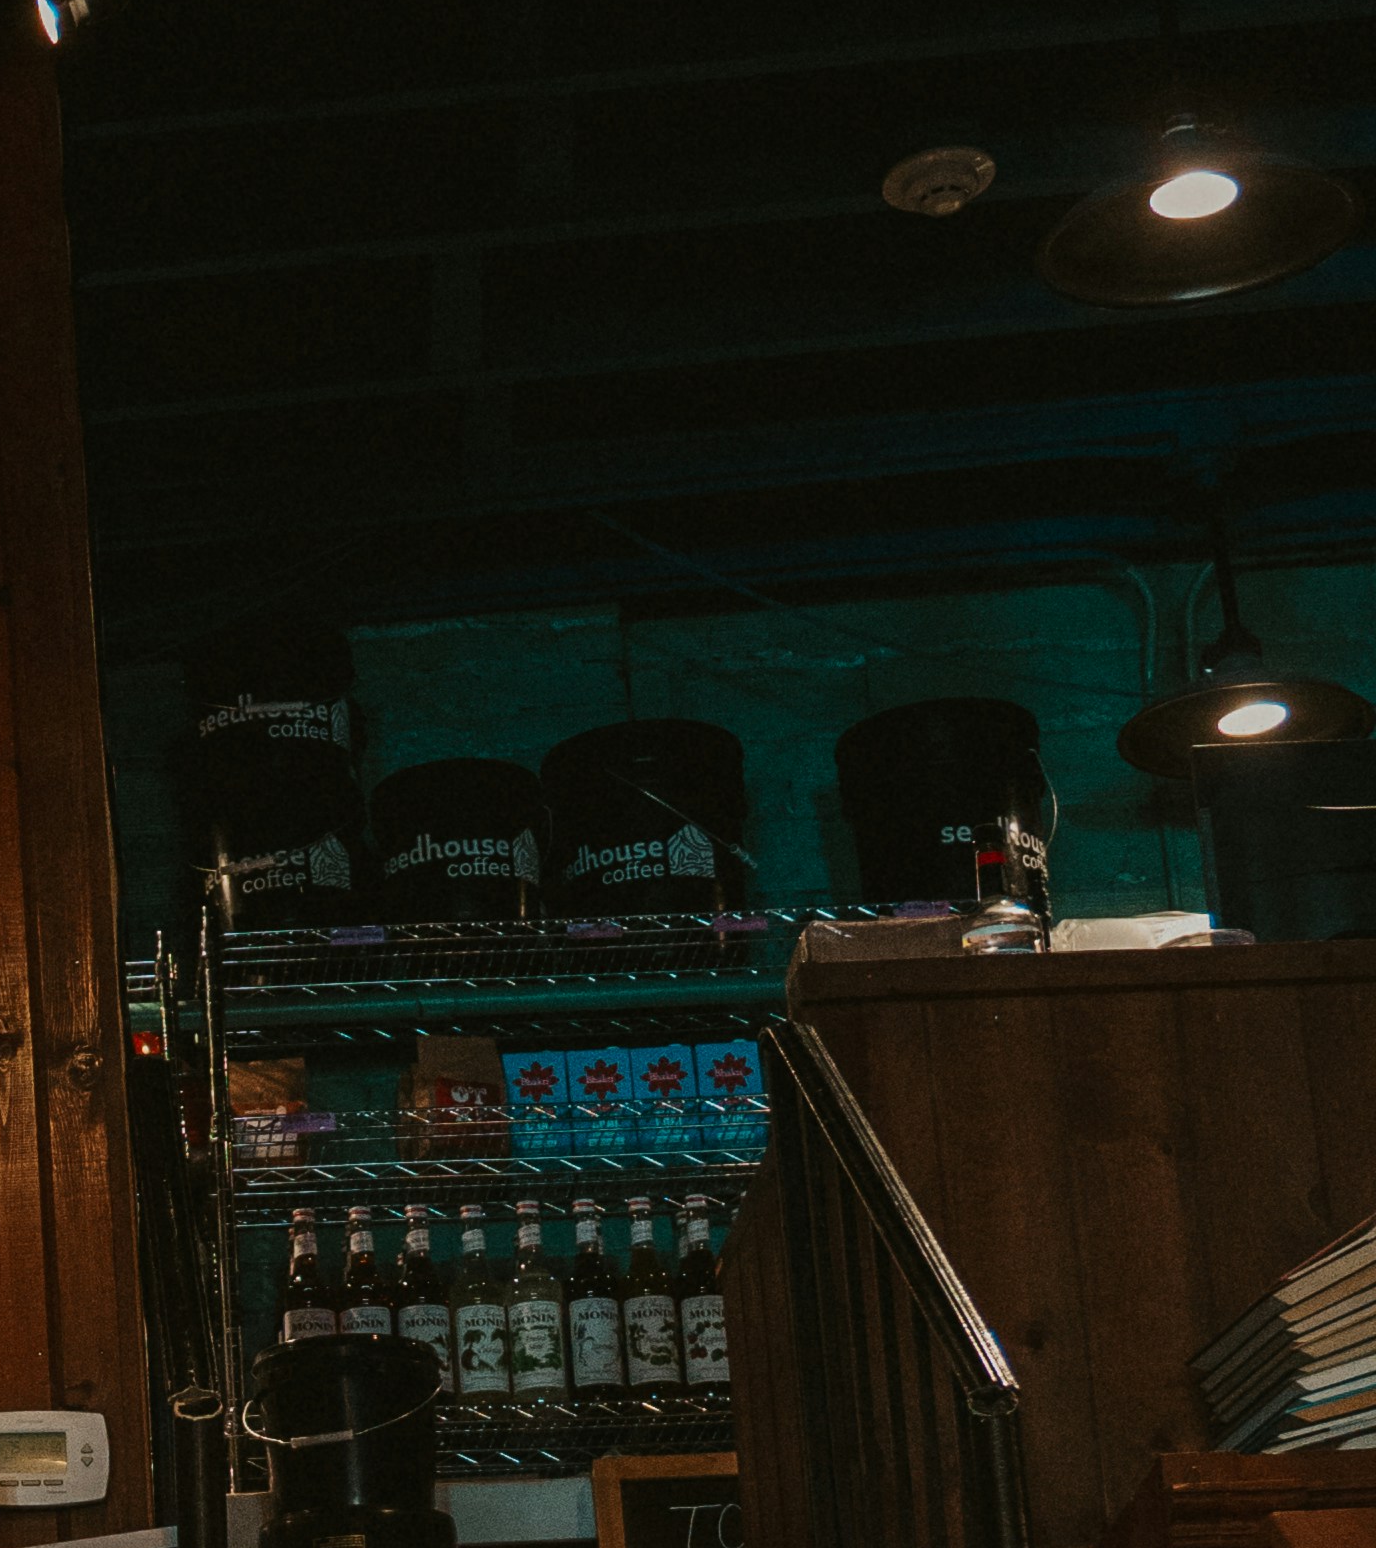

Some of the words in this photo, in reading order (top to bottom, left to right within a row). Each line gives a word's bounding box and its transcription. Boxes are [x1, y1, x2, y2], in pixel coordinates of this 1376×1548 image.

[268, 720, 328, 740] coffee
[447, 858, 510, 877] coffee
[601, 863, 664, 885] coffee
[242, 869, 307, 893] coffee
[512, 1314, 555, 1326] MONIN
